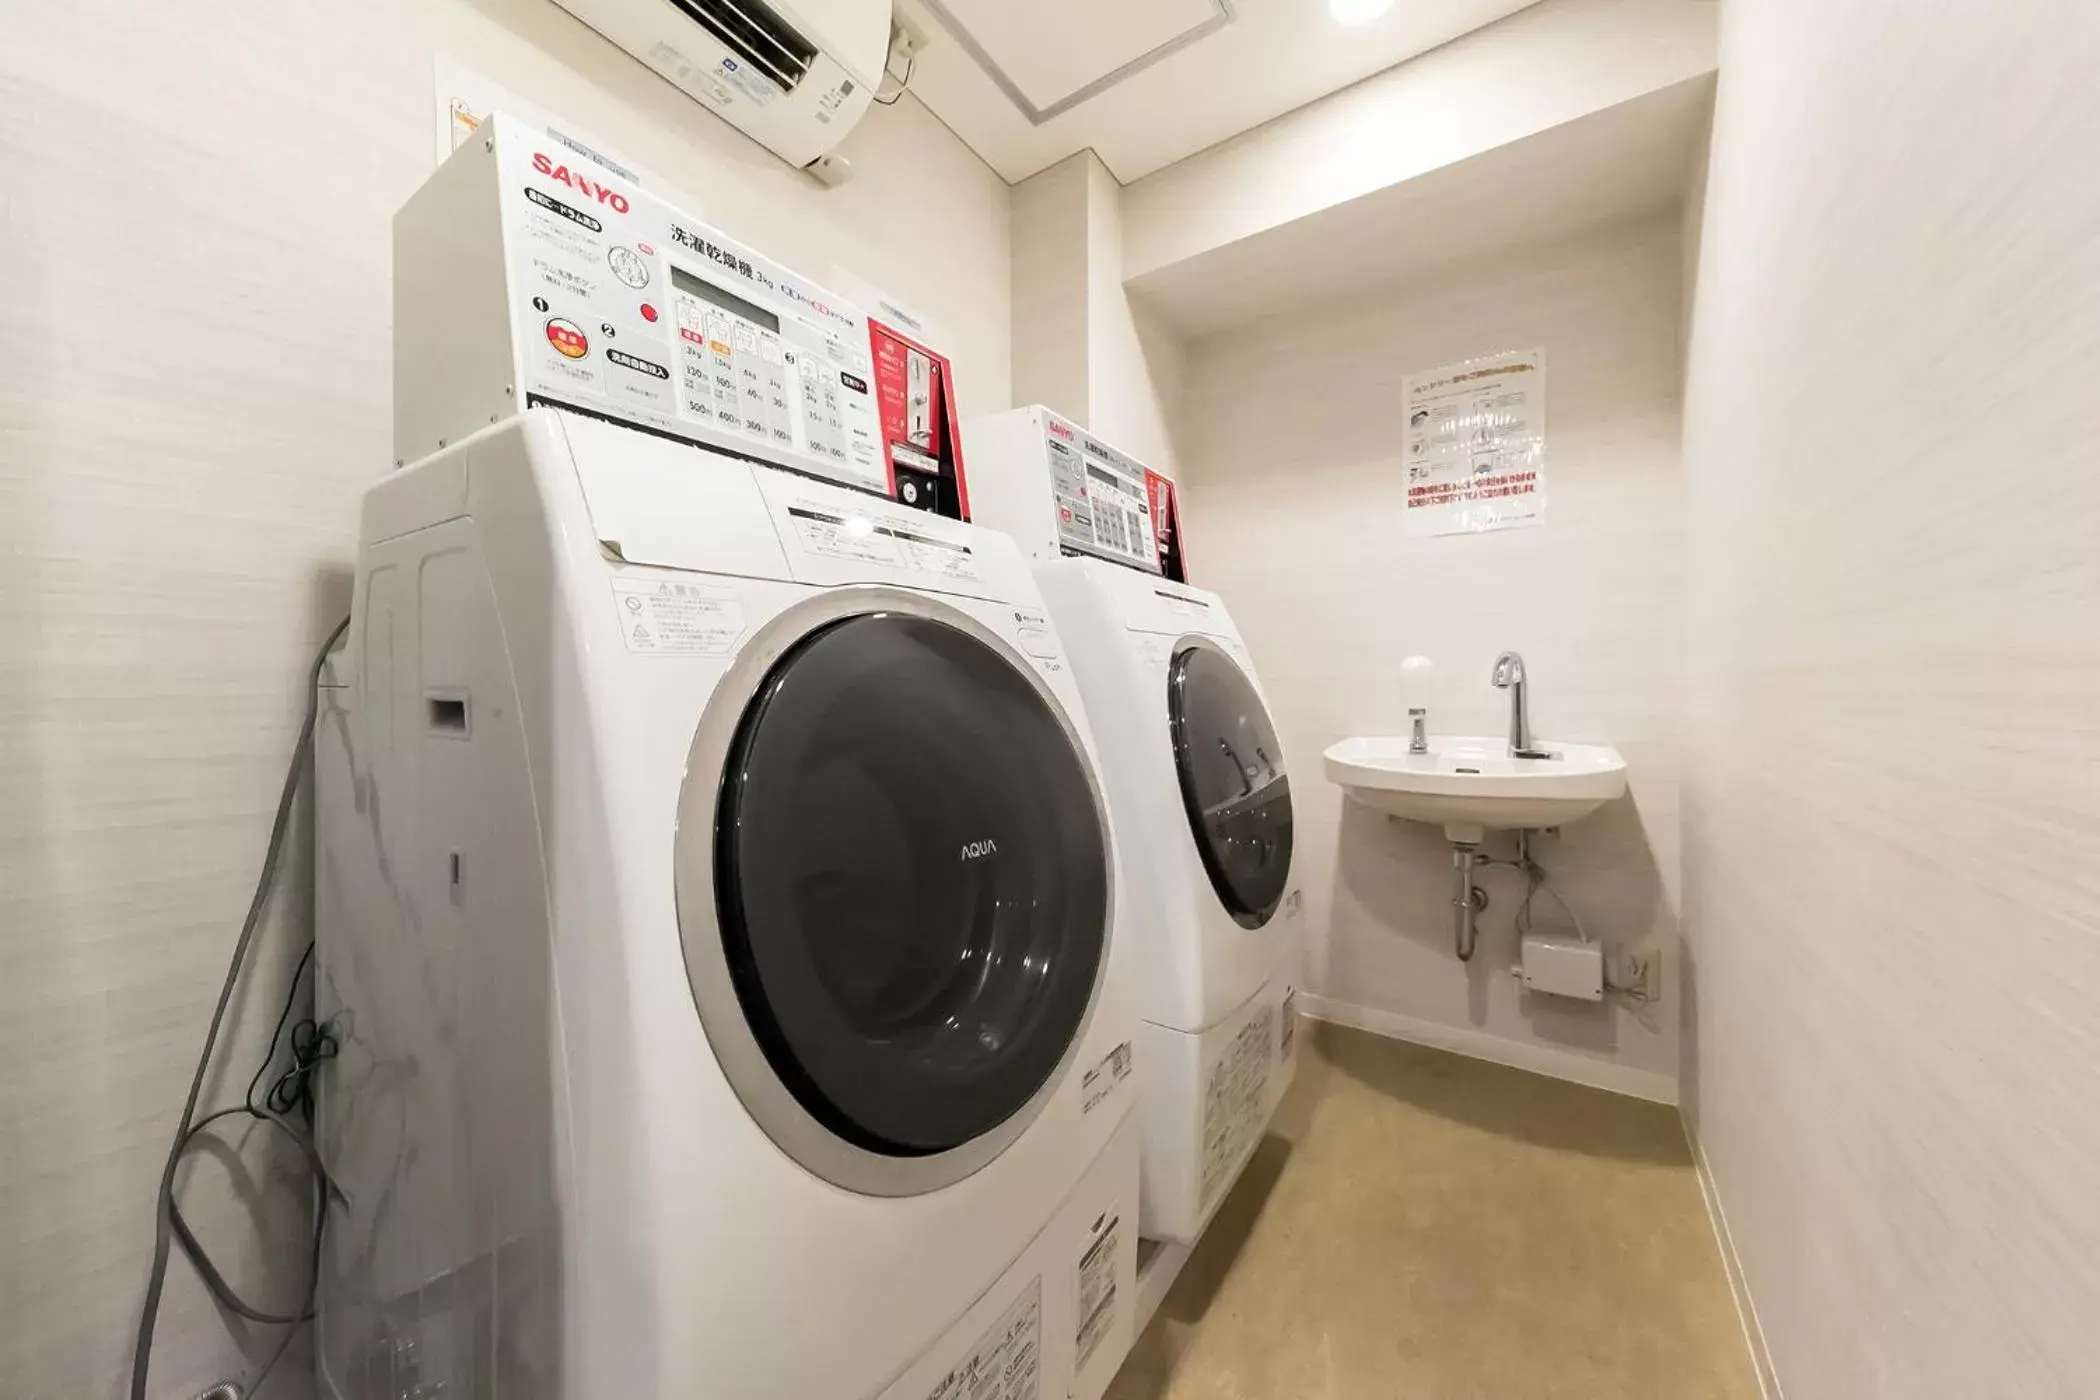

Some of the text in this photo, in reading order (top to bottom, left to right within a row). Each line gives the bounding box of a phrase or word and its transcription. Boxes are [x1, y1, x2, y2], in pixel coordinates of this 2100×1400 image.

[532, 151, 630, 214] SANYO
[671, 223, 754, 281] 洗濯乾燥機
[961, 839, 997, 861] AQUA
